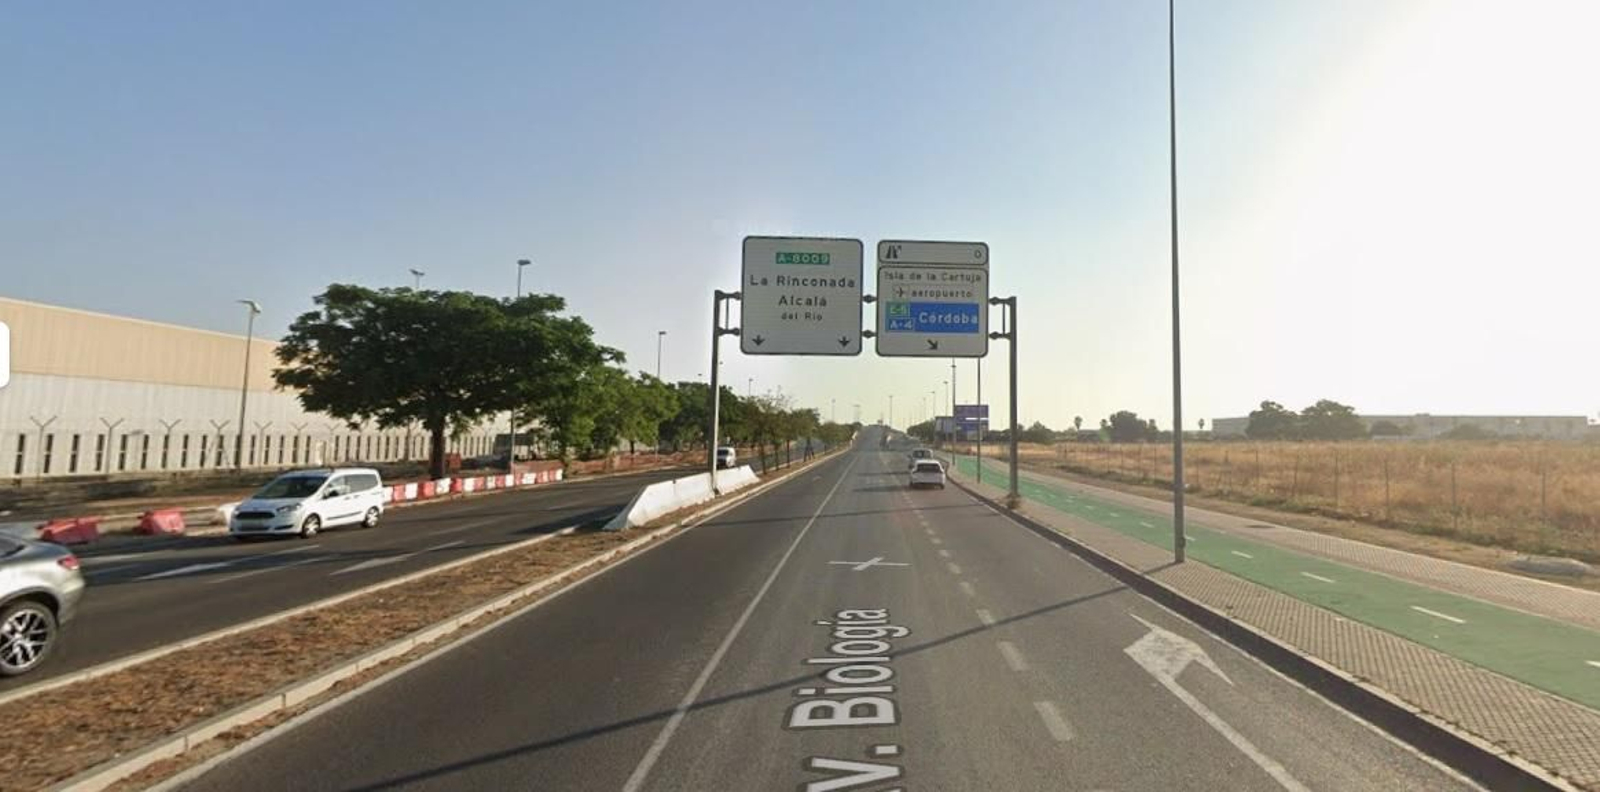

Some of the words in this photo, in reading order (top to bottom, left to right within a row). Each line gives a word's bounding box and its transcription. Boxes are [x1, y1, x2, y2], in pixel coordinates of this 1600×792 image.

[777, 253, 829, 264] A-8009
[750, 275, 768, 286] La
[776, 275, 856, 288] Rinconada
[884, 270, 904, 281] Isla
[909, 271, 922, 281] de
[927, 272, 937, 281] la
[941, 272, 982, 283] Cartuja
[911, 290, 973, 299] aeropuerto
[778, 294, 827, 307] Alcalá
[781, 312, 798, 320] del
[889, 320, 913, 331] A-4
